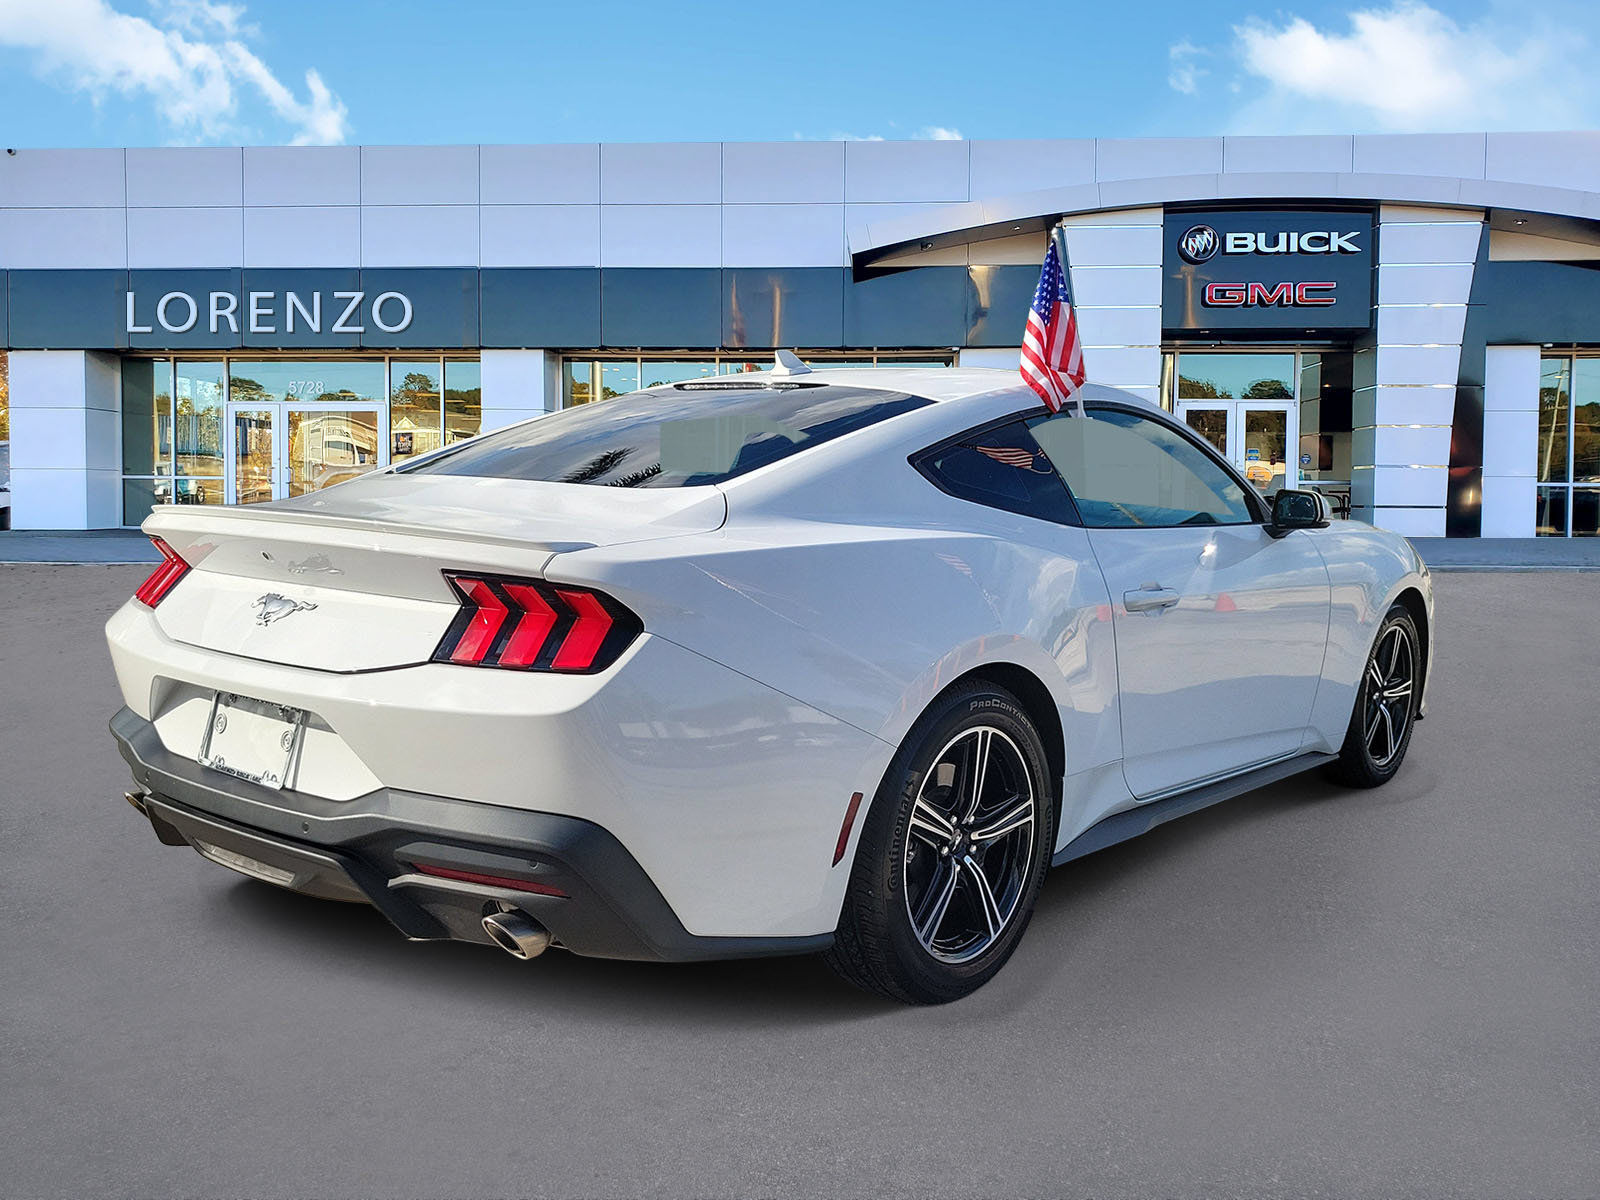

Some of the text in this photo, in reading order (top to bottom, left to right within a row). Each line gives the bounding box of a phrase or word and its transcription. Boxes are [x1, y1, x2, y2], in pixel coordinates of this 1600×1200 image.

[1225, 231, 1362, 253] BUICK
[1205, 281, 1337, 306] GMC
[126, 291, 413, 333] LORENZO
[288, 380, 325, 394] 5728
[887, 791, 912, 892] Continental
